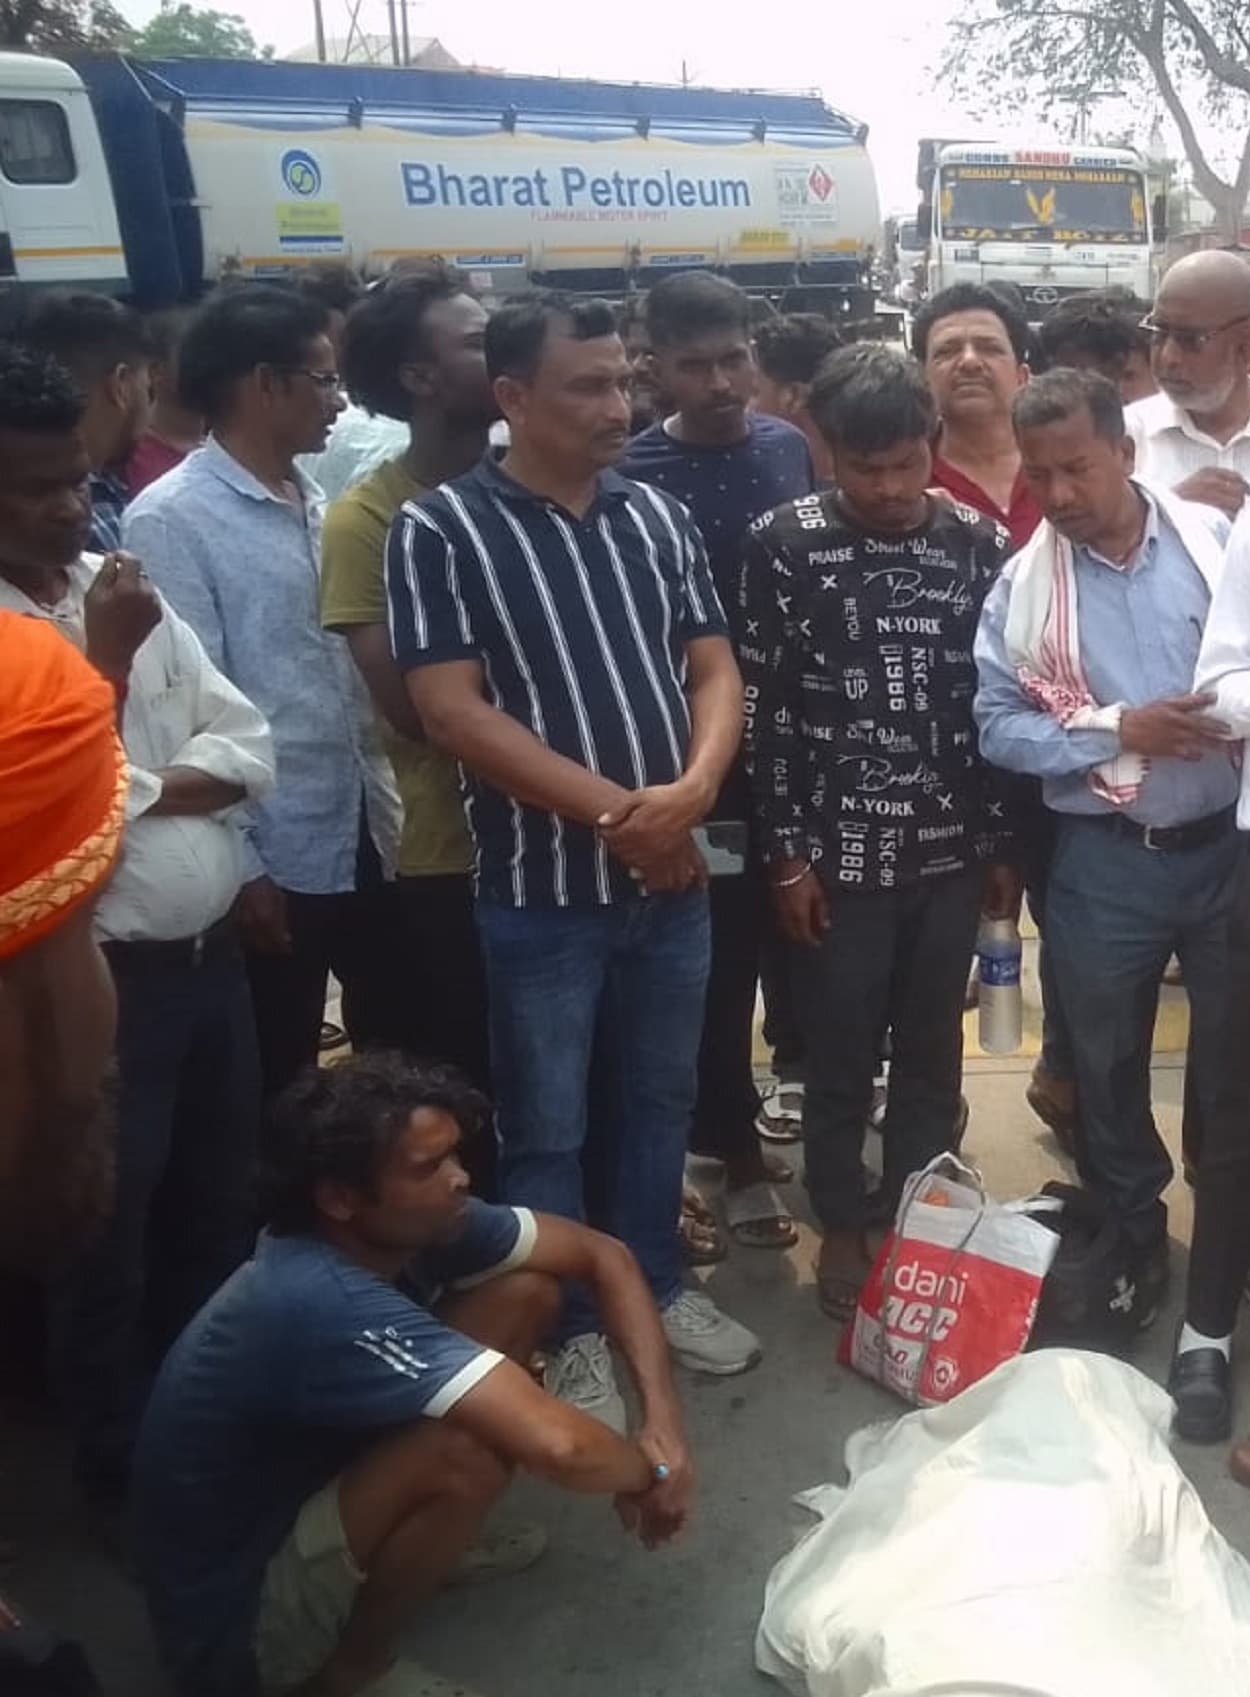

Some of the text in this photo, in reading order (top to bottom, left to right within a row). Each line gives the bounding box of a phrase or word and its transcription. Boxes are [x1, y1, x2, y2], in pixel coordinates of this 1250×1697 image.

[401, 162, 548, 206] Bharat
[561, 167, 751, 208] Petroleum
[808, 546, 855, 567] PRAISE
[876, 616, 942, 635] N-YORK
[844, 678, 869, 700] UP
[841, 795, 915, 817] N-YORK
[882, 1258, 970, 1306] dani
